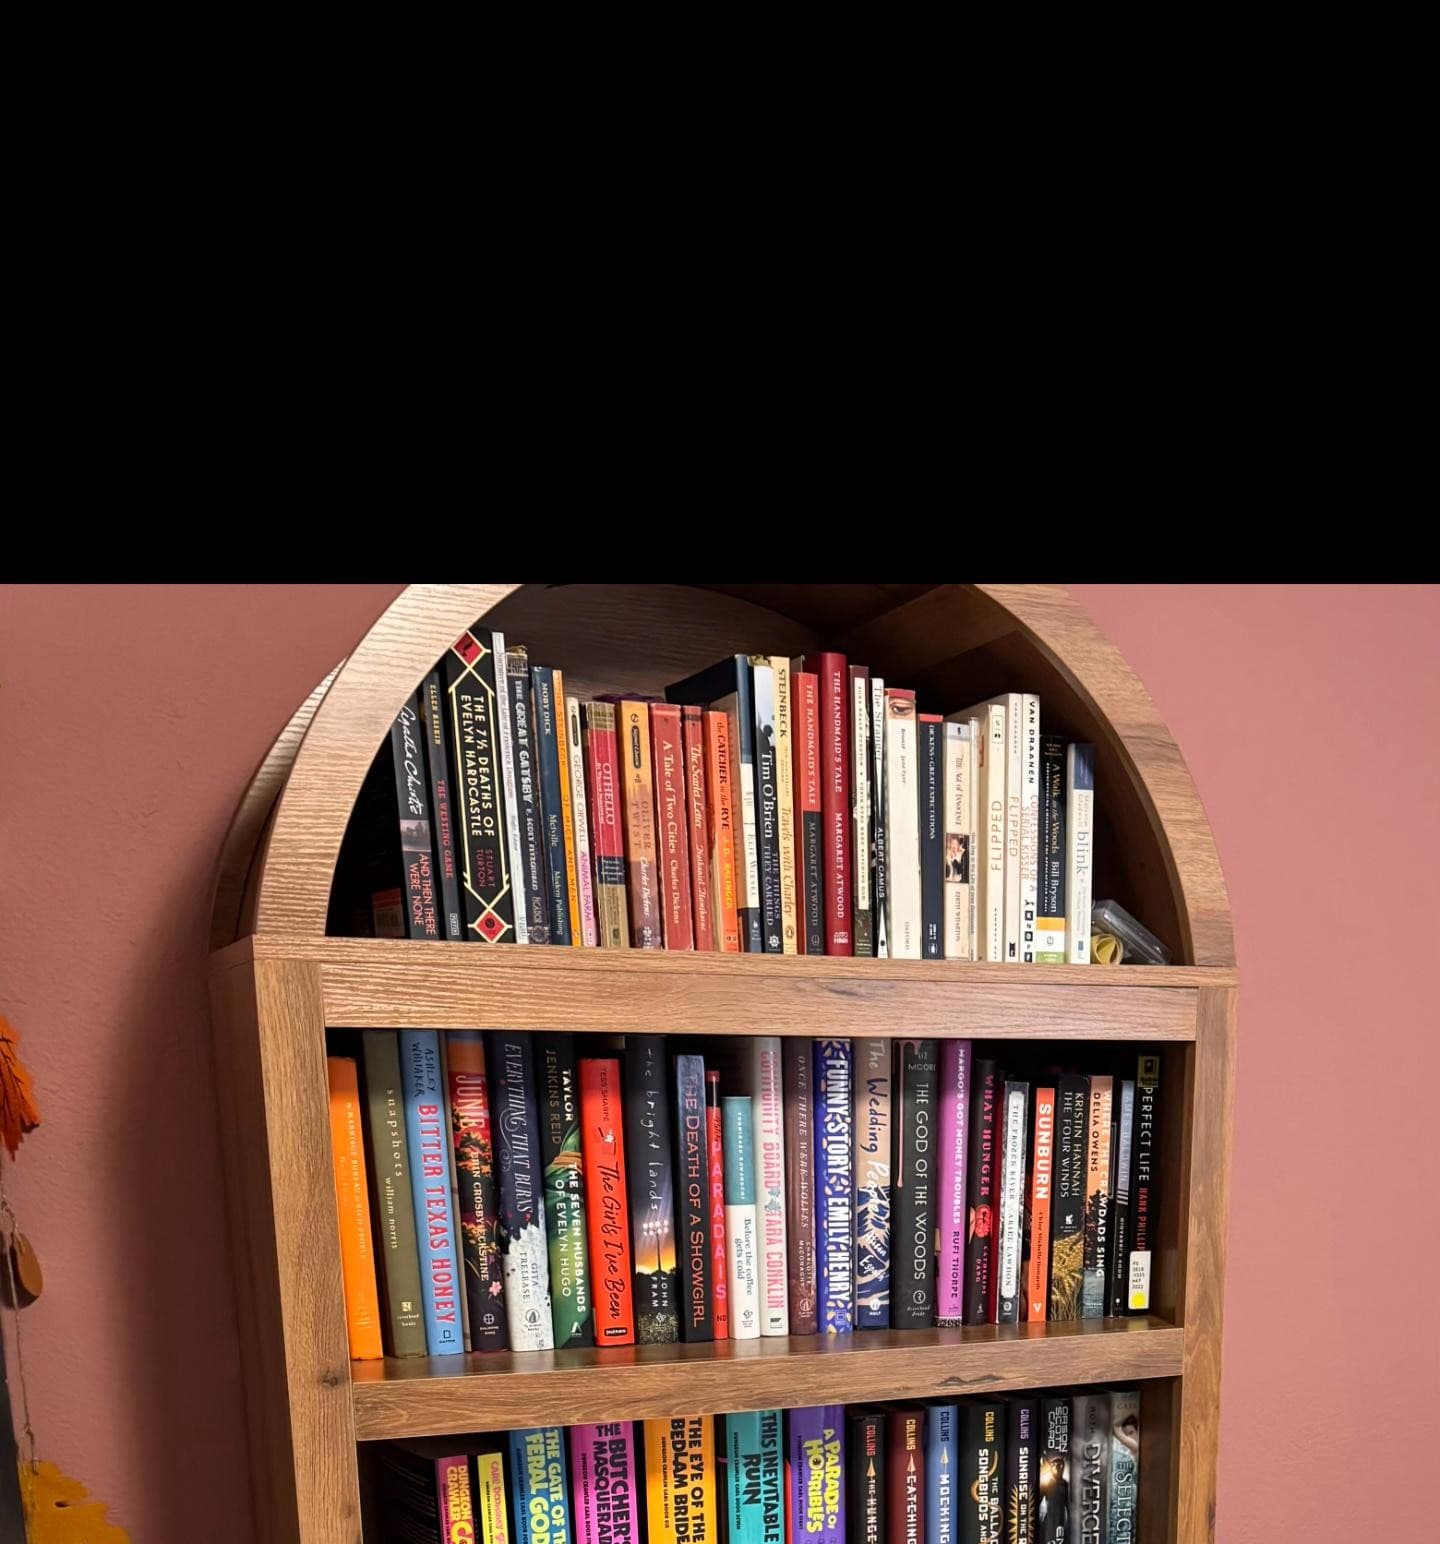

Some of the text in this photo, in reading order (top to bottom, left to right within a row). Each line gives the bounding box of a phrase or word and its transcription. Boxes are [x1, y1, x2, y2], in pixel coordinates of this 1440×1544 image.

[473, 697, 485, 722] THE
[517, 699, 529, 748] GREAT
[779, 668, 787, 737] STEINBECK
[834, 693, 842, 764] HANDMAID'S
[461, 695, 482, 836] EVELYN HARDCASTLE
[479, 758, 492, 815] DEATHS
[520, 751, 533, 803] GATSBY
[603, 763, 616, 825] OTHELLO
[761, 750, 775, 837] Tim O'Brien
[484, 819, 494, 836] OF
[578, 803, 586, 844] ORWELL
[663, 742, 677, 853] A Tale of Two Cities
[582, 852, 590, 889] ANIMAL
[835, 813, 844, 870] MARGARET
[1077, 832, 1089, 873] blink
[409, 863, 424, 925] WERE NONE
[419, 854, 436, 935] AND THEN THERE
[585, 892, 593, 921] FARM
[562, 1070, 574, 1122] TAYLOR
[860, 1078, 888, 1153] Wedding
[387, 1089, 402, 1177] snapshots
[1036, 1104, 1051, 1200] SUNBURN
[1061, 1092, 1073, 1198] THE FOUR WINDS
[1072, 1093, 1084, 1197] KRISTIN HANNAH
[1091, 1130, 1099, 1172] OWENS
[1140, 1087, 1152, 1181] PERFECT LIFE
[685, 1078, 704, 1327] THE DEATH OF A SHOWGIRL
[826, 1059, 849, 1302] FUNNY STORY EMILY HENRY
[915, 1083, 929, 1280] THE GOD OF THE WOODS
[384, 1177, 397, 1249] william norris
[418, 1104, 456, 1323] BITTER TEXAS HONEY
[555, 1180, 571, 1296] OF EVELYN HUGO
[568, 1163, 586, 1312] THE SEVEN HUSBANDS
[597, 1164, 625, 1318] The Girls I've Been
[734, 1238, 745, 1280] gets cold
[744, 1219, 754, 1296] Before the coffee
[650, 1275, 658, 1308] FRAM
[546, 1429, 558, 1459] THE
[596, 1424, 621, 1436] THE
[823, 1428, 835, 1439] A
[907, 1419, 916, 1450] COLLINS
[941, 1411, 950, 1442] COLLINS
[447, 1466, 460, 1521] CRAWLER
[458, 1465, 471, 1519] DUNGEON
[525, 1433, 544, 1495] FERAL
[550, 1464, 561, 1502] GATE
[671, 1419, 689, 1544] BEDLAM BRIDE
[689, 1418, 705, 1543] THE EYE OF THE
[741, 1454, 761, 1505] RUIN
[761, 1413, 779, 1543] THIS INEVITABLE
[804, 1440, 824, 1533] HORRIBLES
[824, 1440, 841, 1513] PARADE
[1019, 1447, 1029, 1500] SUNRISE
[552, 1507, 564, 1524] OF
[1020, 1504, 1025, 1512] ON
